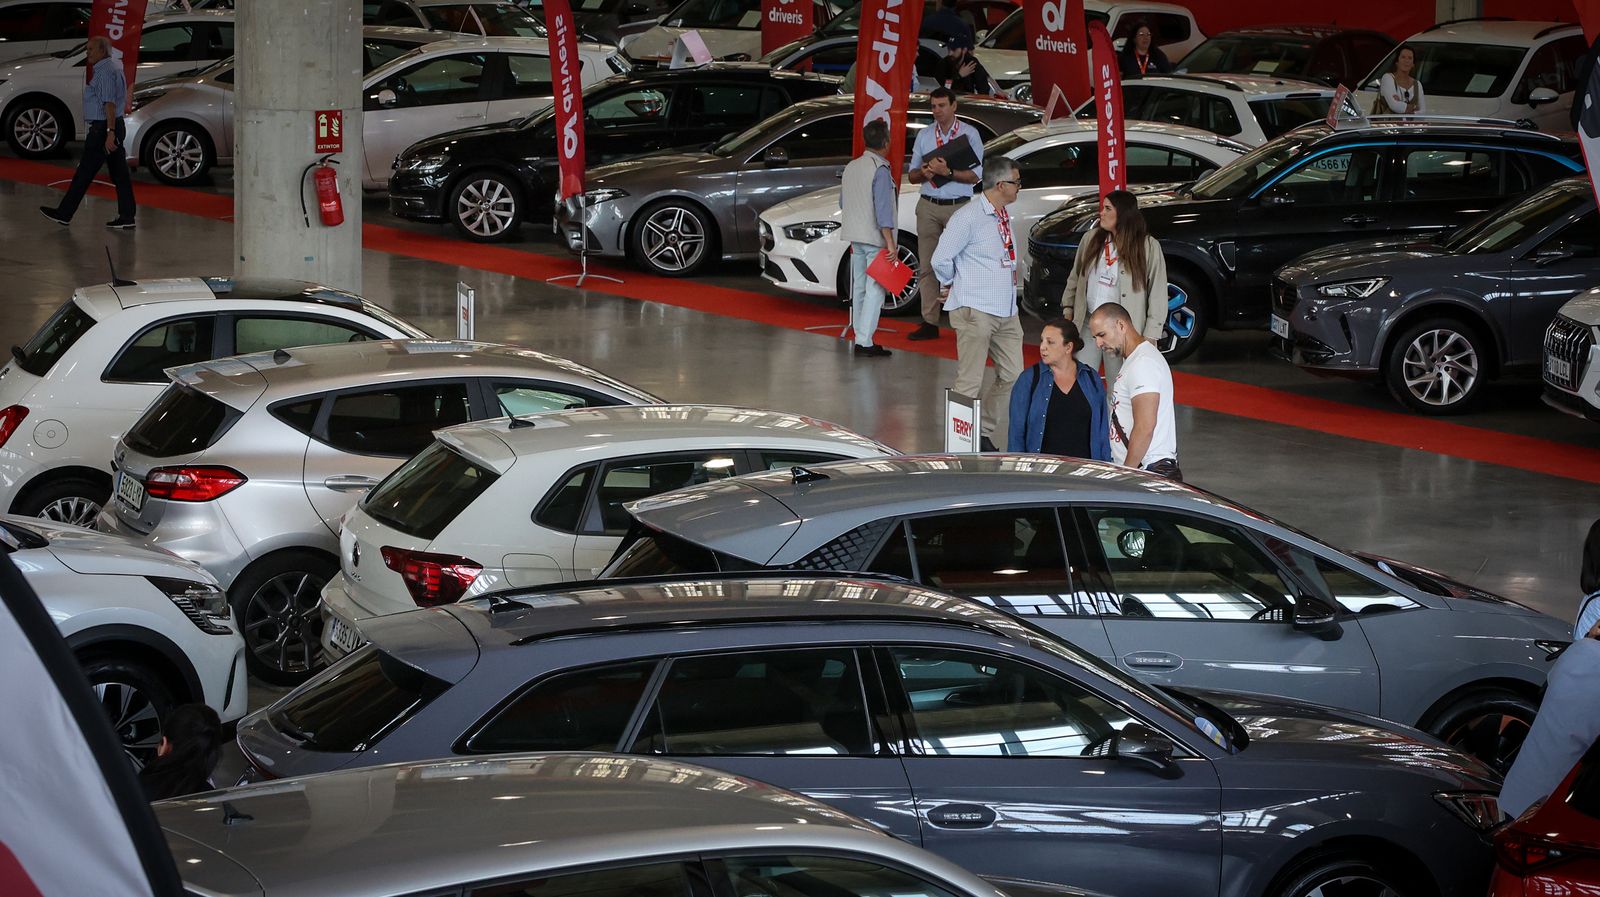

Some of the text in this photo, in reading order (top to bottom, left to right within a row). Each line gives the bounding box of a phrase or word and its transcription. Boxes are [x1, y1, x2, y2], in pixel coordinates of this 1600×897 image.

[768, 6, 803, 25] driveris
[1035, 34, 1077, 54] driveris
[952, 417, 974, 437] TERRY
